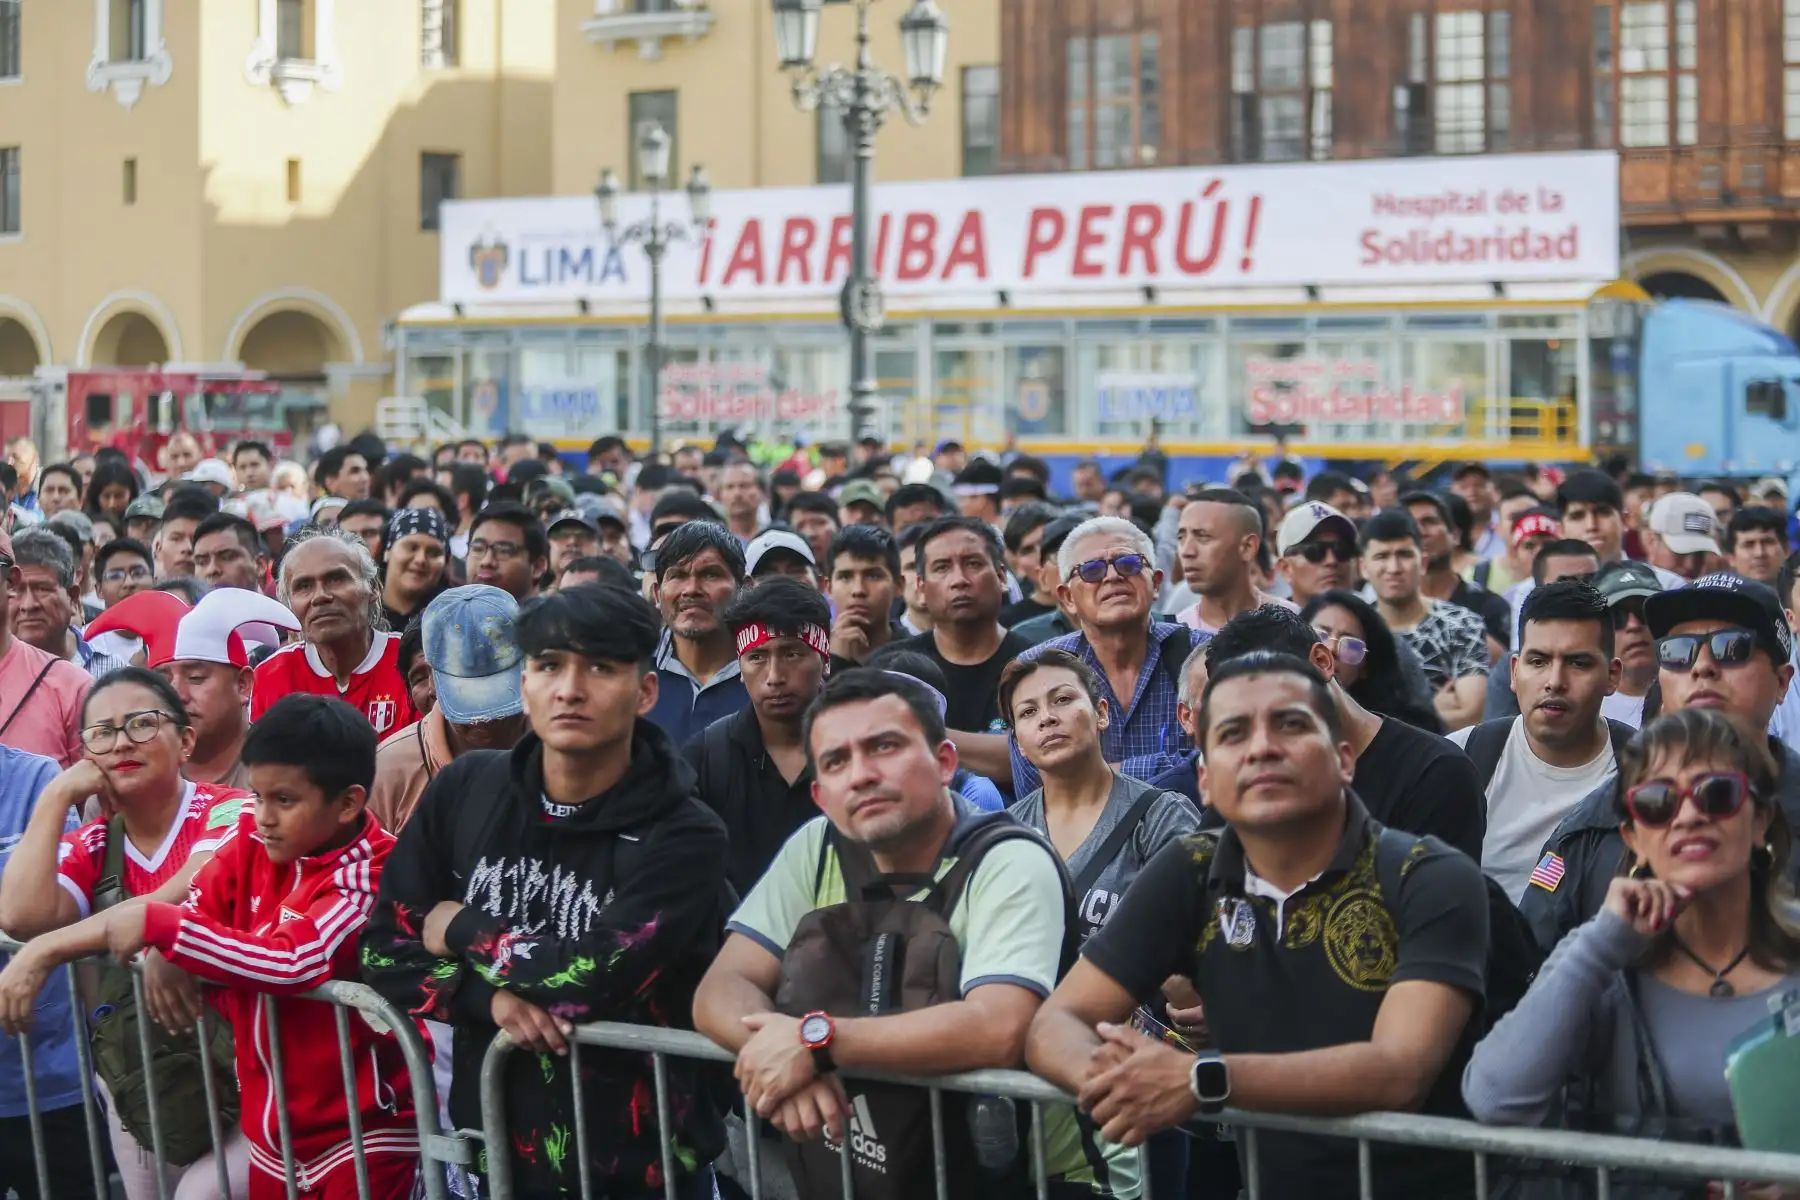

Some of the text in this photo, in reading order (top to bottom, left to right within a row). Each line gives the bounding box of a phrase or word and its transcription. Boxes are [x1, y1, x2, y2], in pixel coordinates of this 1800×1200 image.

[1372, 185, 1563, 218] Hospital de la
[1021, 178, 1263, 280] PERÚ!
[1360, 223, 1579, 266] Solidaridad
[519, 245, 627, 286] LIMA
